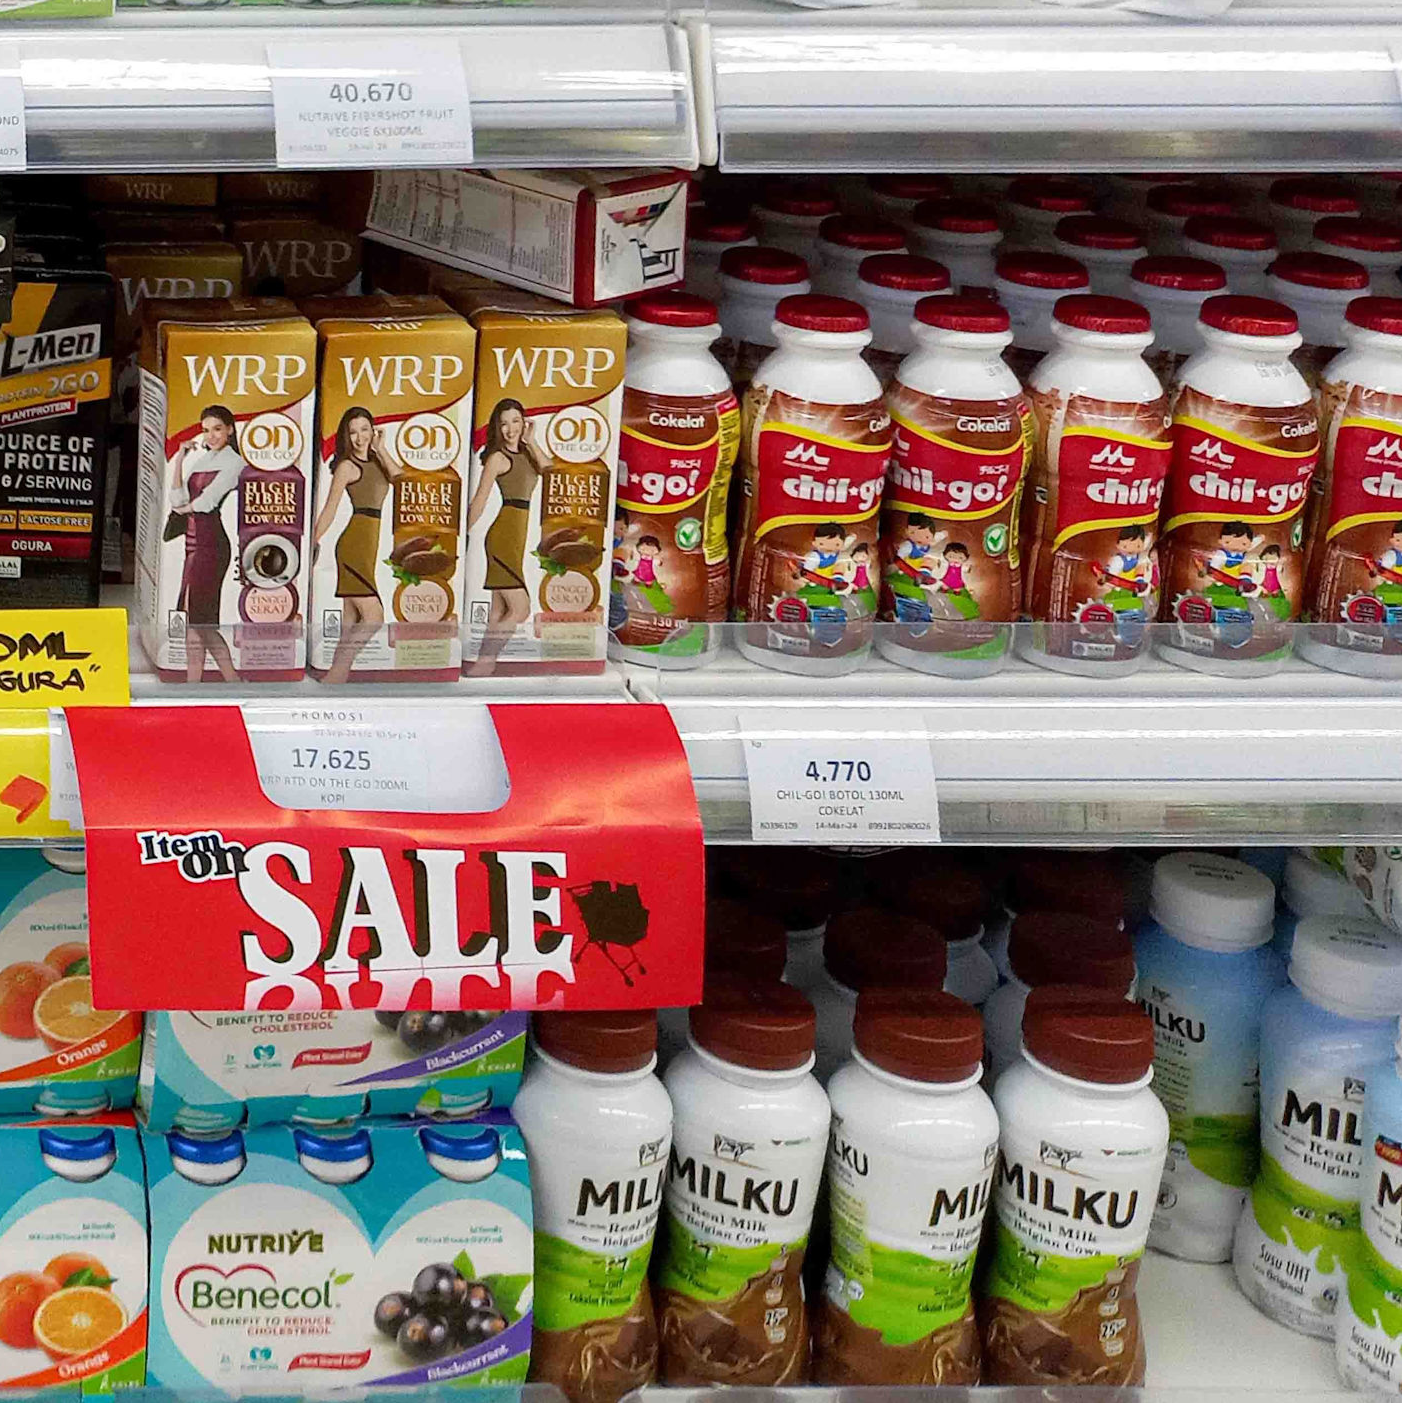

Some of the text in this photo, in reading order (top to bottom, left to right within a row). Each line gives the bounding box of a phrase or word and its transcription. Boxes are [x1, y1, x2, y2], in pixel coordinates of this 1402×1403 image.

[183, 354, 308, 397] WRP
[492, 346, 615, 389] WRP
[648, 414, 706, 430] Cokelat
[320, 794, 345, 804] KOPI
[819, 805, 865, 817] COKELAT
[829, 790, 863, 801] BOTOL
[867, 790, 904, 801] 130ML
[142, 834, 221, 864] Item
[182, 845, 248, 879] on
[242, 843, 574, 977] SALE
[424, 1029, 505, 1071] Blackcurrant
[998, 1150, 1138, 1229] MILKU
